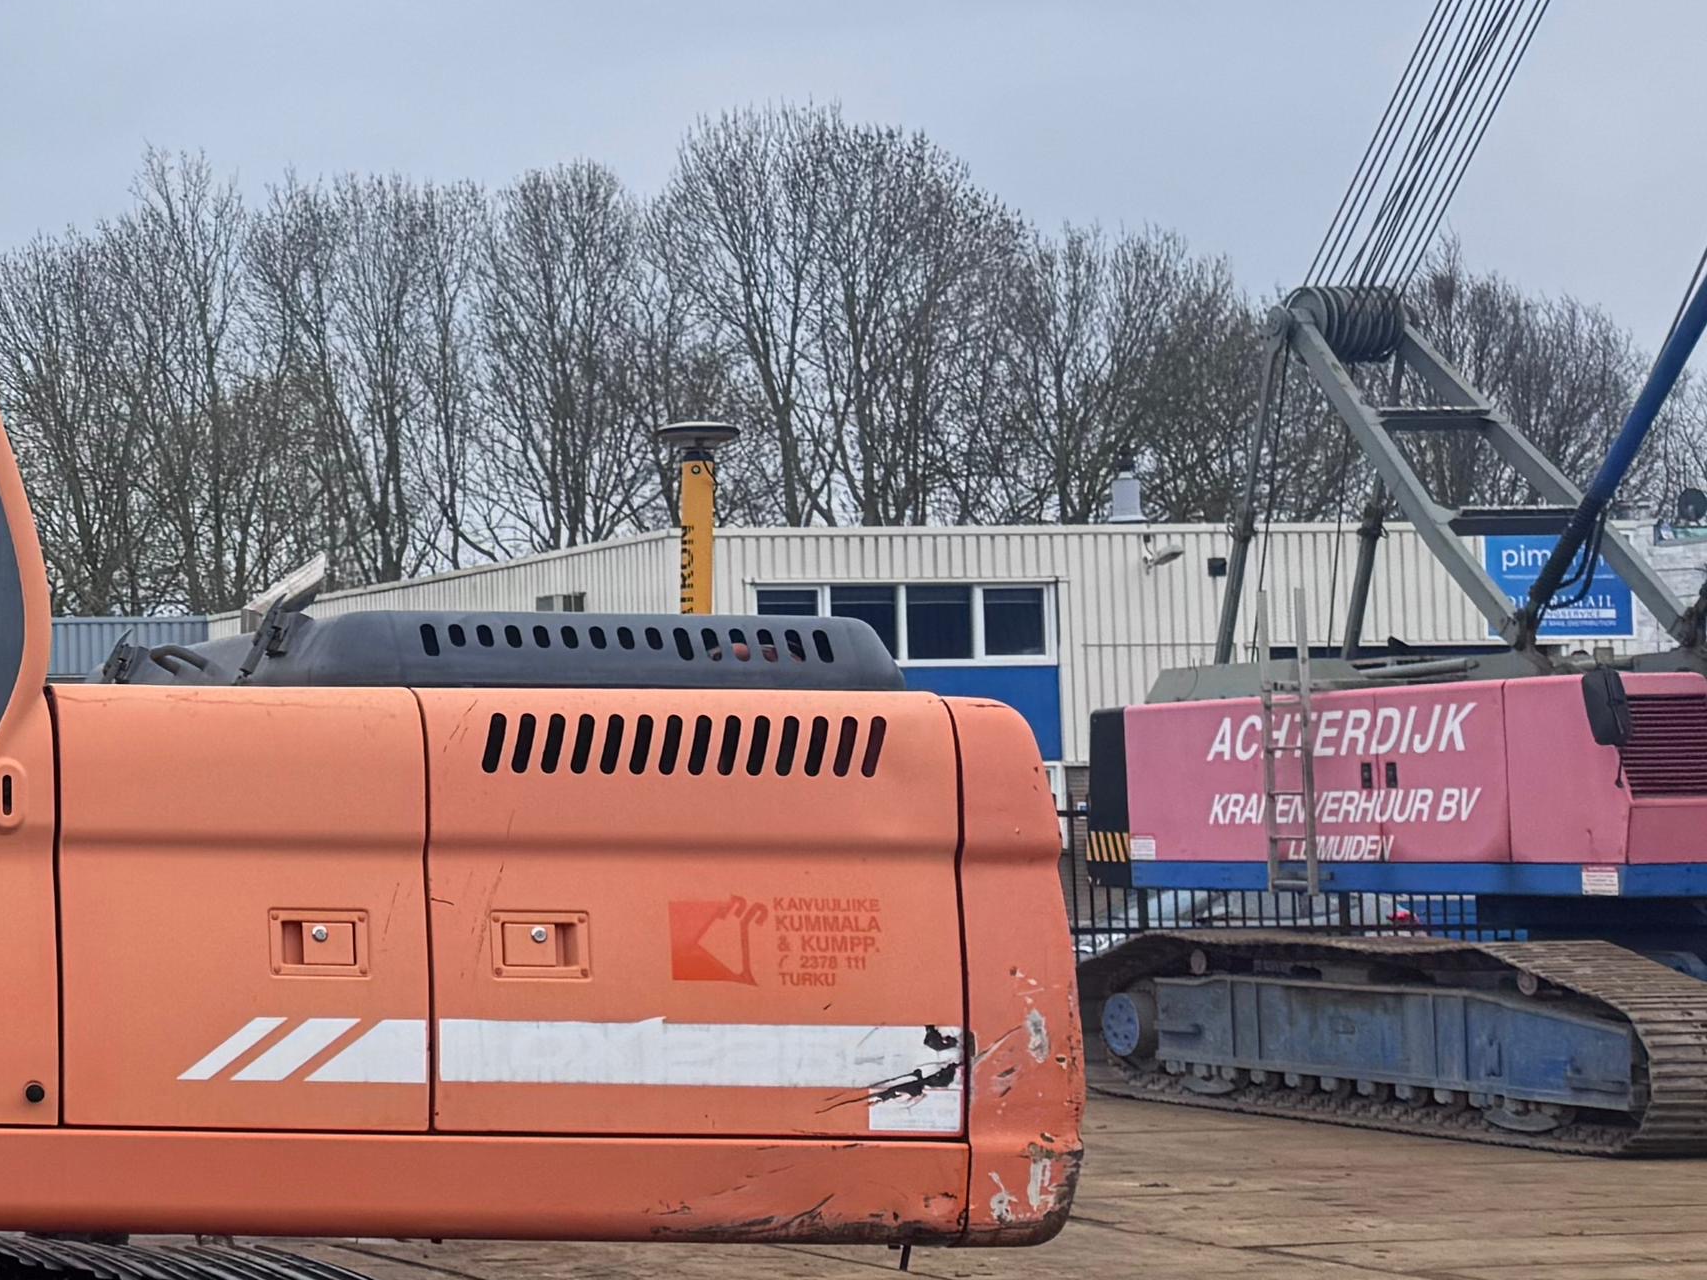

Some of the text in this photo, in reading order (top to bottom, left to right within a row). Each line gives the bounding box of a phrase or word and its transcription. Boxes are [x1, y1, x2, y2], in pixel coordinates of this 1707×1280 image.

[1209, 787, 1481, 825] KRAENVERHUUR BV
[1288, 834, 1394, 861] LMUIDEN
[775, 915, 881, 933] KUMMALA
[777, 935, 880, 953] & KUMPP.
[800, 956, 837, 970] 2378
[779, 972, 837, 987] TURKU
